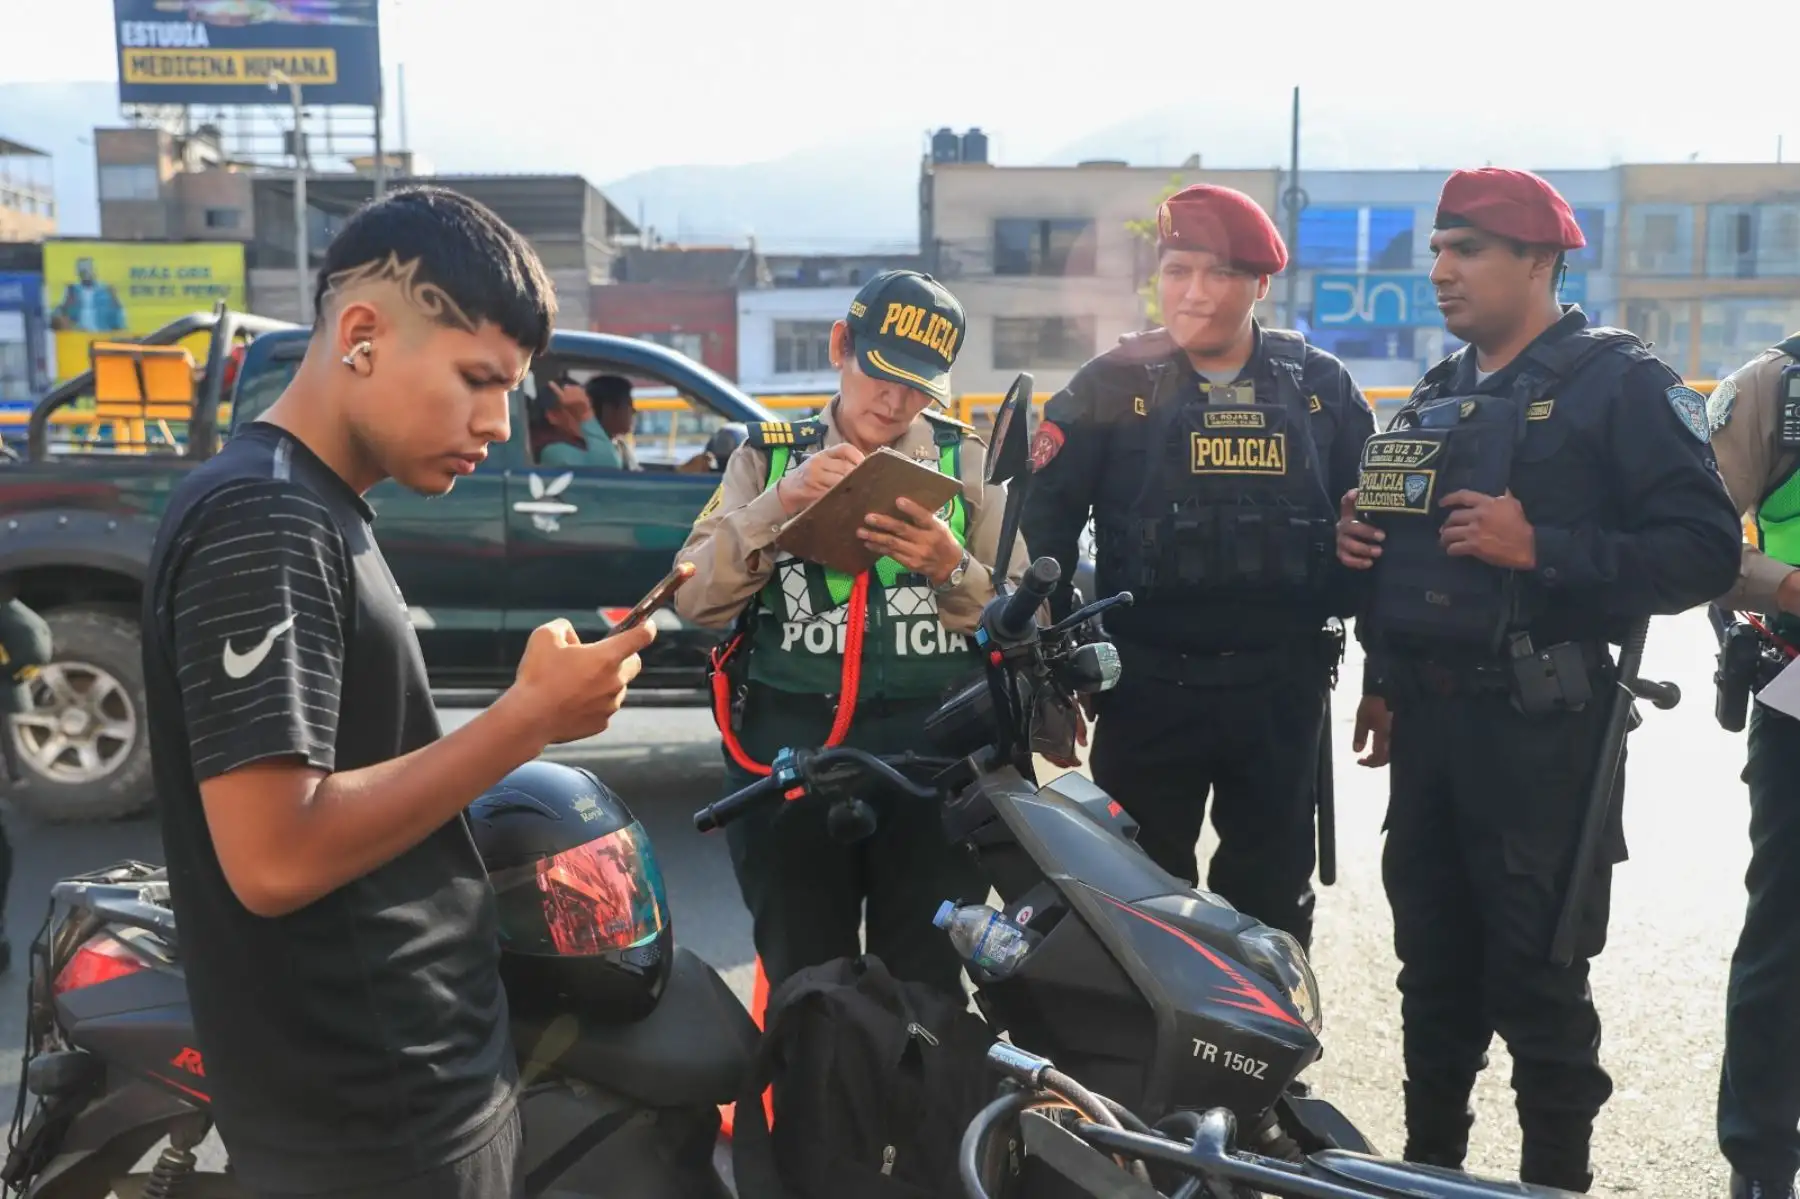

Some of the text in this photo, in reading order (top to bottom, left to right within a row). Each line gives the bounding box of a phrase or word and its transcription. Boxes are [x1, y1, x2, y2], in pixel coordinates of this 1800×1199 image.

[121, 21, 209, 47] ESTUDIA
[132, 55, 330, 78] MEDICINA HUMANA
[880, 303, 959, 363] POLICIA
[1197, 438, 1281, 467] POLICIA
[1383, 444, 1410, 455] CRUZ
[1360, 472, 1404, 490] POLICIA
[1192, 1038, 1269, 1080] TR 150Z
